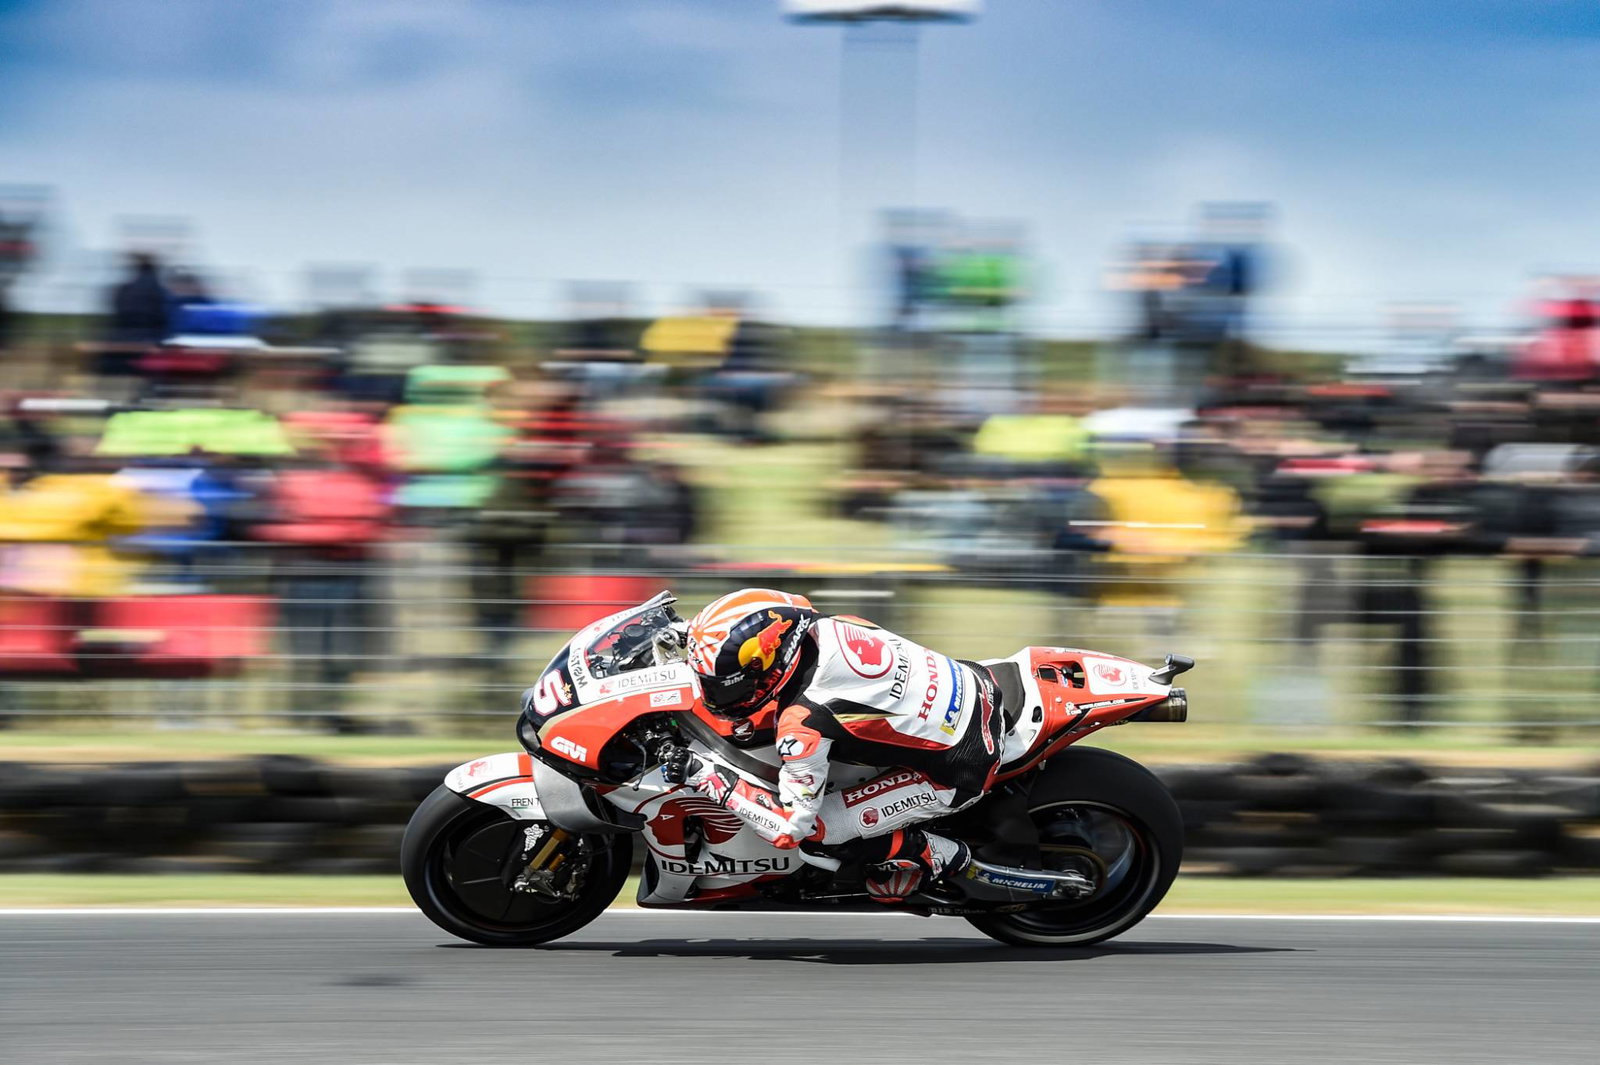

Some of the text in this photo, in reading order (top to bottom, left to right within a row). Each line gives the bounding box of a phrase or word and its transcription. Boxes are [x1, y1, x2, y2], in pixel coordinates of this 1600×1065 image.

[783, 613, 811, 664] SHARK
[617, 669, 677, 689] IDEMITSU
[846, 772, 922, 804] HONDA
[511, 797, 534, 807] FREN
[881, 791, 938, 818] IDEMITSU
[738, 806, 781, 832] IDEMITSU
[661, 856, 790, 875] IDEMITSU
[992, 877, 1047, 890] MICHELIN
